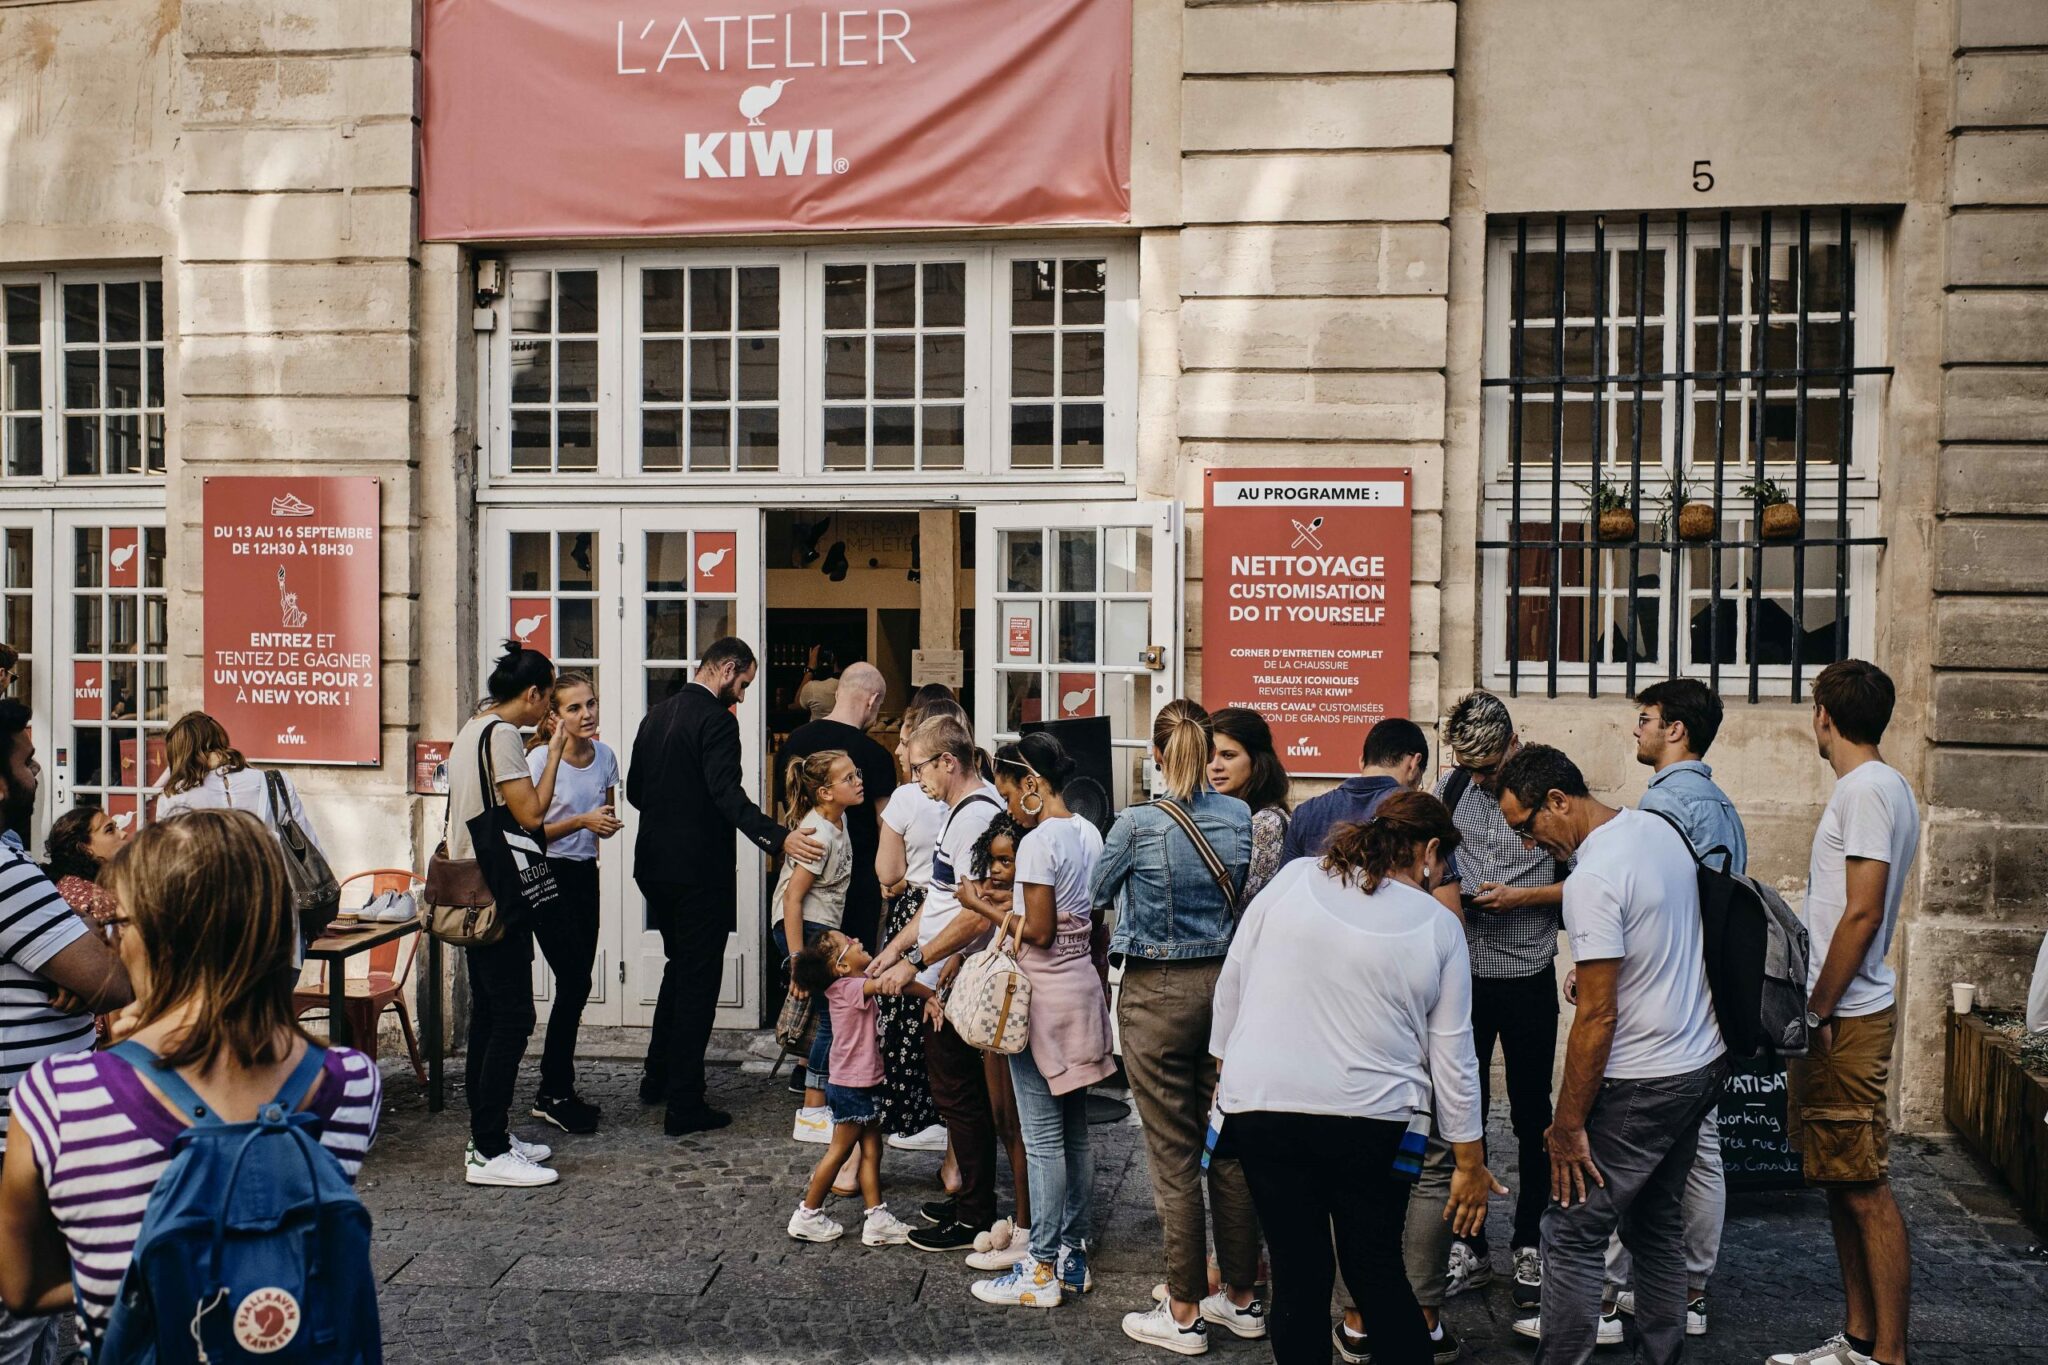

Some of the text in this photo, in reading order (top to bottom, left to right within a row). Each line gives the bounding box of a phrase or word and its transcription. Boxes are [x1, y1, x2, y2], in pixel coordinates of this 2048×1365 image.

[616, 9, 917, 74] L'ATELIER
[1693, 160, 1715, 193] 5
[1237, 487, 1260, 501] AU
[1264, 487, 1370, 501] PROGRAMME
[214, 526, 373, 539] DU 13 AU 16 SEPTEMBRE
[232, 541, 354, 556] DE 12H30 À 18H30
[1231, 556, 1385, 577] NETTOYAGE
[1229, 584, 1385, 600] CUSTOMISATION
[1229, 606, 1385, 622] DO IT YOURSELF
[250, 632, 336, 649] ENTREZ ET
[215, 650, 372, 668] TENTEZ DE GAGNER
[1230, 648, 1384, 659] CORNER D'ENTRETIEN COMPLET
[1263, 660, 1349, 670] DE LA CHAUSSURE
[213, 669, 373, 688] UN VOYAGE POUR 2
[1252, 675, 1360, 686] TABLEAUX ICONIQUES
[235, 686, 350, 706] À NEW YORK !
[1258, 686, 1303, 696] REVISITÉS
[1305, 687, 1323, 696] PAR
[1318, 702, 1384, 713] CUSTOMISÉES
[1285, 714, 1298, 723] DE
[1300, 714, 1341, 724] GRANDS
